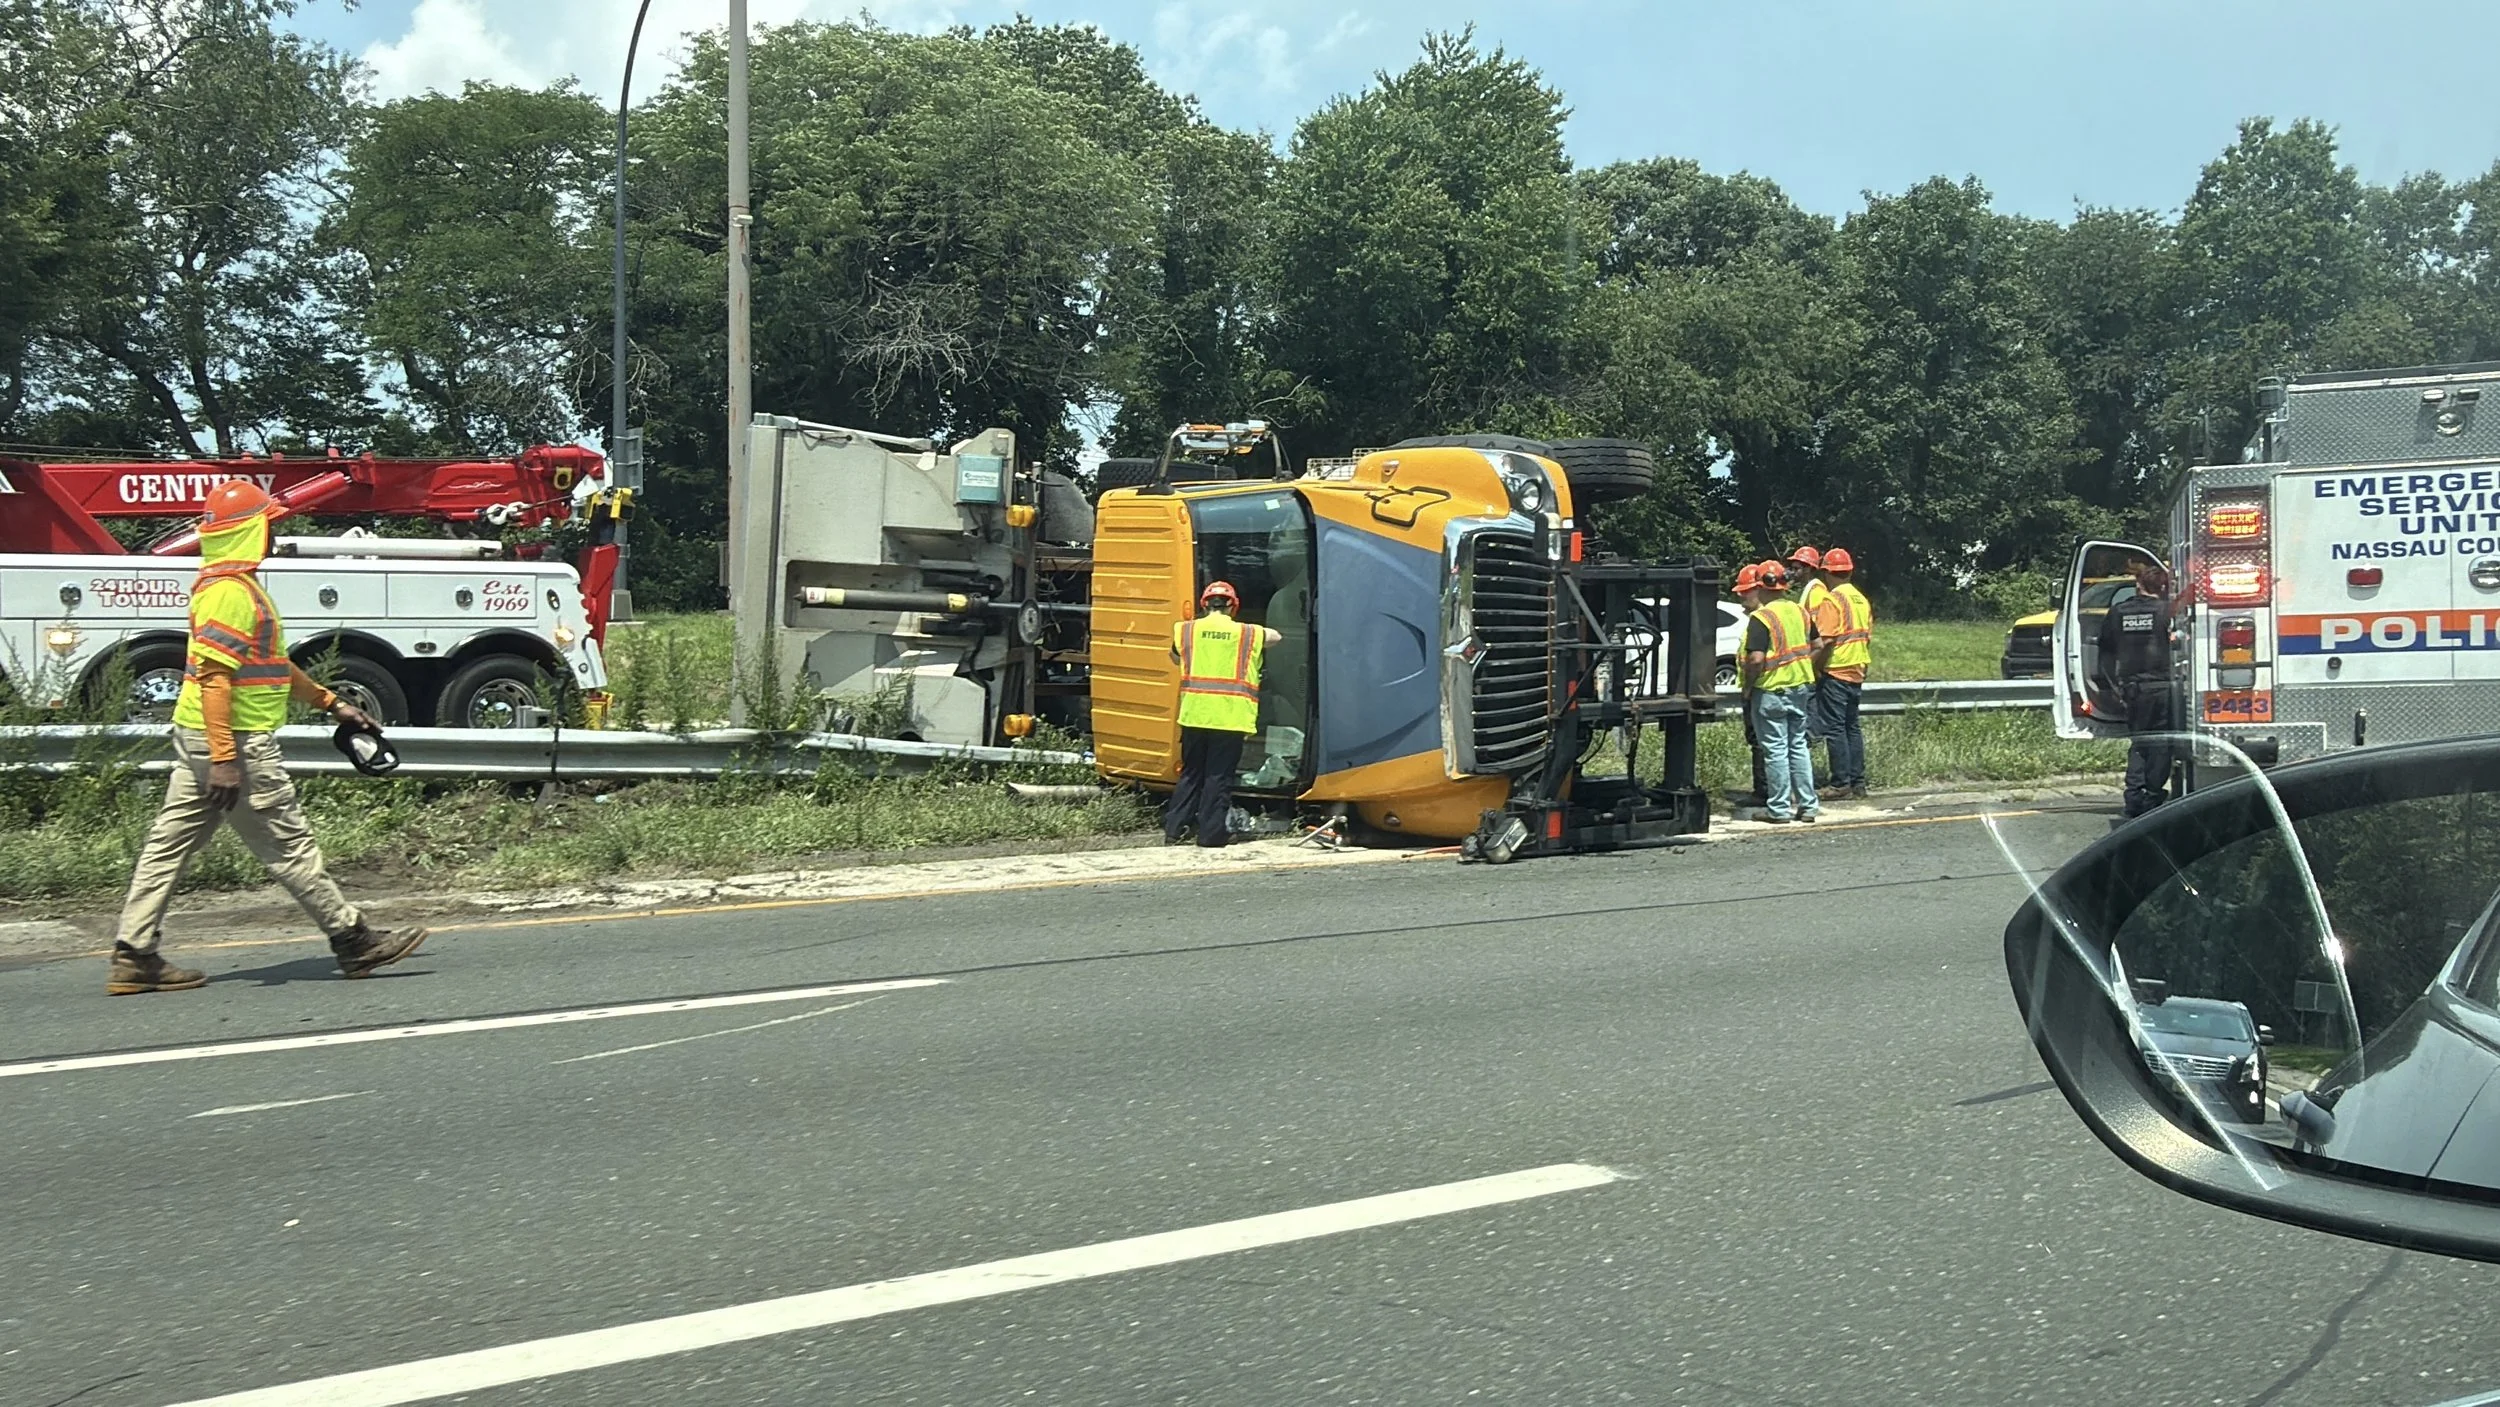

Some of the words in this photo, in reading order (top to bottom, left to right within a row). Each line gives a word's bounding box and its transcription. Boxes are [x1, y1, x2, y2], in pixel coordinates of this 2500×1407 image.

[119, 474, 276, 503] CENTY
[2315, 471, 2500, 498] EMERGE
[2400, 513, 2500, 535] UNIT
[2332, 539, 2446, 560] NASSAU
[2457, 537, 2500, 555] CO
[482, 580, 530, 595] Est.
[98, 591, 190, 607] TOWING
[483, 597, 529, 611] 1969
[2122, 619, 2153, 627] POLICE
[2320, 613, 2500, 650] POLI
[2207, 698, 2269, 713] 2423
